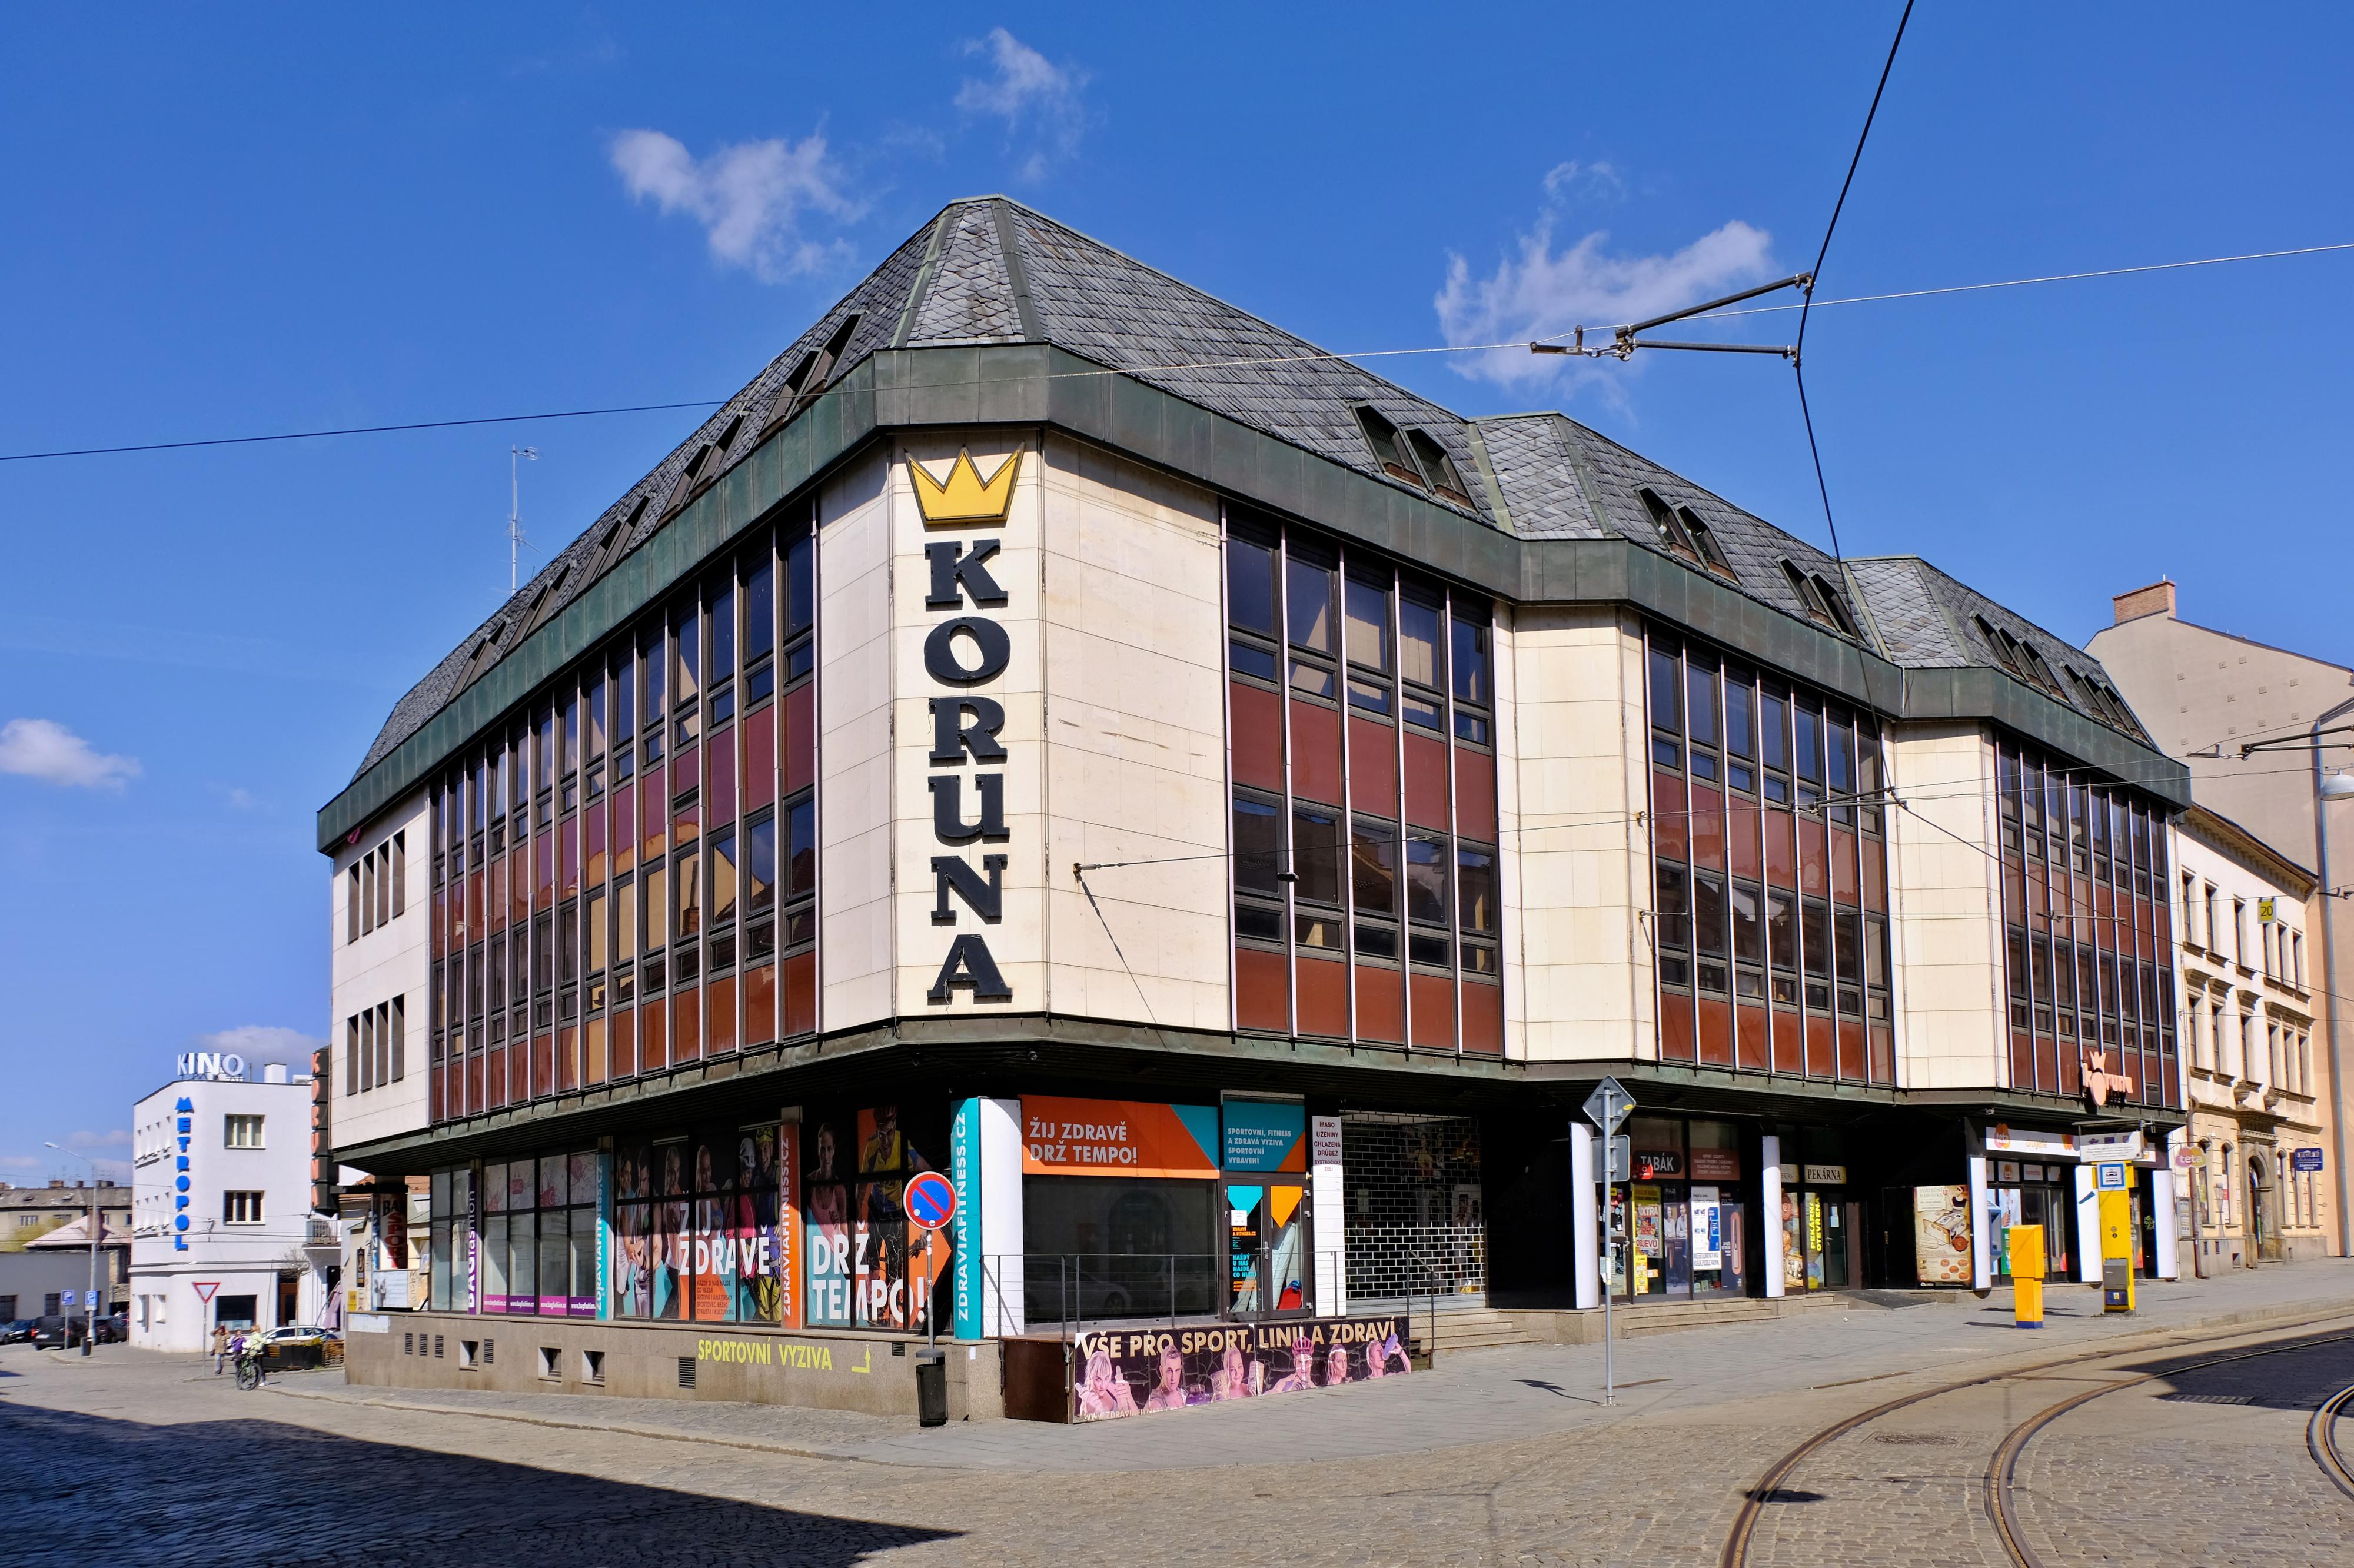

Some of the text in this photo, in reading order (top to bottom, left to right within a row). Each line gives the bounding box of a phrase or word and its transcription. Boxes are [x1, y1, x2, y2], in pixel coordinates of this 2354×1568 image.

[925, 538, 1013, 1003] KORUNA
[2260, 905, 2273, 916] 20
[178, 1053, 244, 1075] KINO
[1030, 1117, 1127, 1142] ŽIJ ZDRAVĚ
[1228, 1127, 1266, 1137] SPORTOVNÍ,
[1234, 1136, 1260, 1145] ZDRAVÁ
[1261, 1137, 1283, 1146] VÝŽIVA
[1030, 1140, 1138, 1164] DRŽ TEMPO!
[1228, 1156, 1259, 1164] VYBAVENÍ
[1640, 1152, 1674, 1171] TABÁK
[2180, 1154, 2203, 1163] teta
[175, 1097, 194, 1251] METROPOL
[1807, 1168, 1841, 1180] PEKÁRNA
[782, 1138, 791, 1317] ZDRAVIAFITNESS.CZ
[957, 1112, 968, 1322] ZDRAVIAFITNESS.CZ
[679, 1224, 770, 1276] ZDRAVĚ
[813, 1220, 870, 1274] DRŽ
[1636, 1239, 1657, 1248] OBJEVŮ
[812, 1276, 926, 1323] TEMPO!
[1080, 1331, 1122, 1360] VŠE
[1129, 1334, 1174, 1357] PRO
[1182, 1329, 1252, 1354] SPORT,
[1312, 1326, 1324, 1346] A
[1329, 1316, 1395, 1344] ZDRAVÍ
[698, 1337, 833, 1370] SPORTOVNÍ VYZIVA
